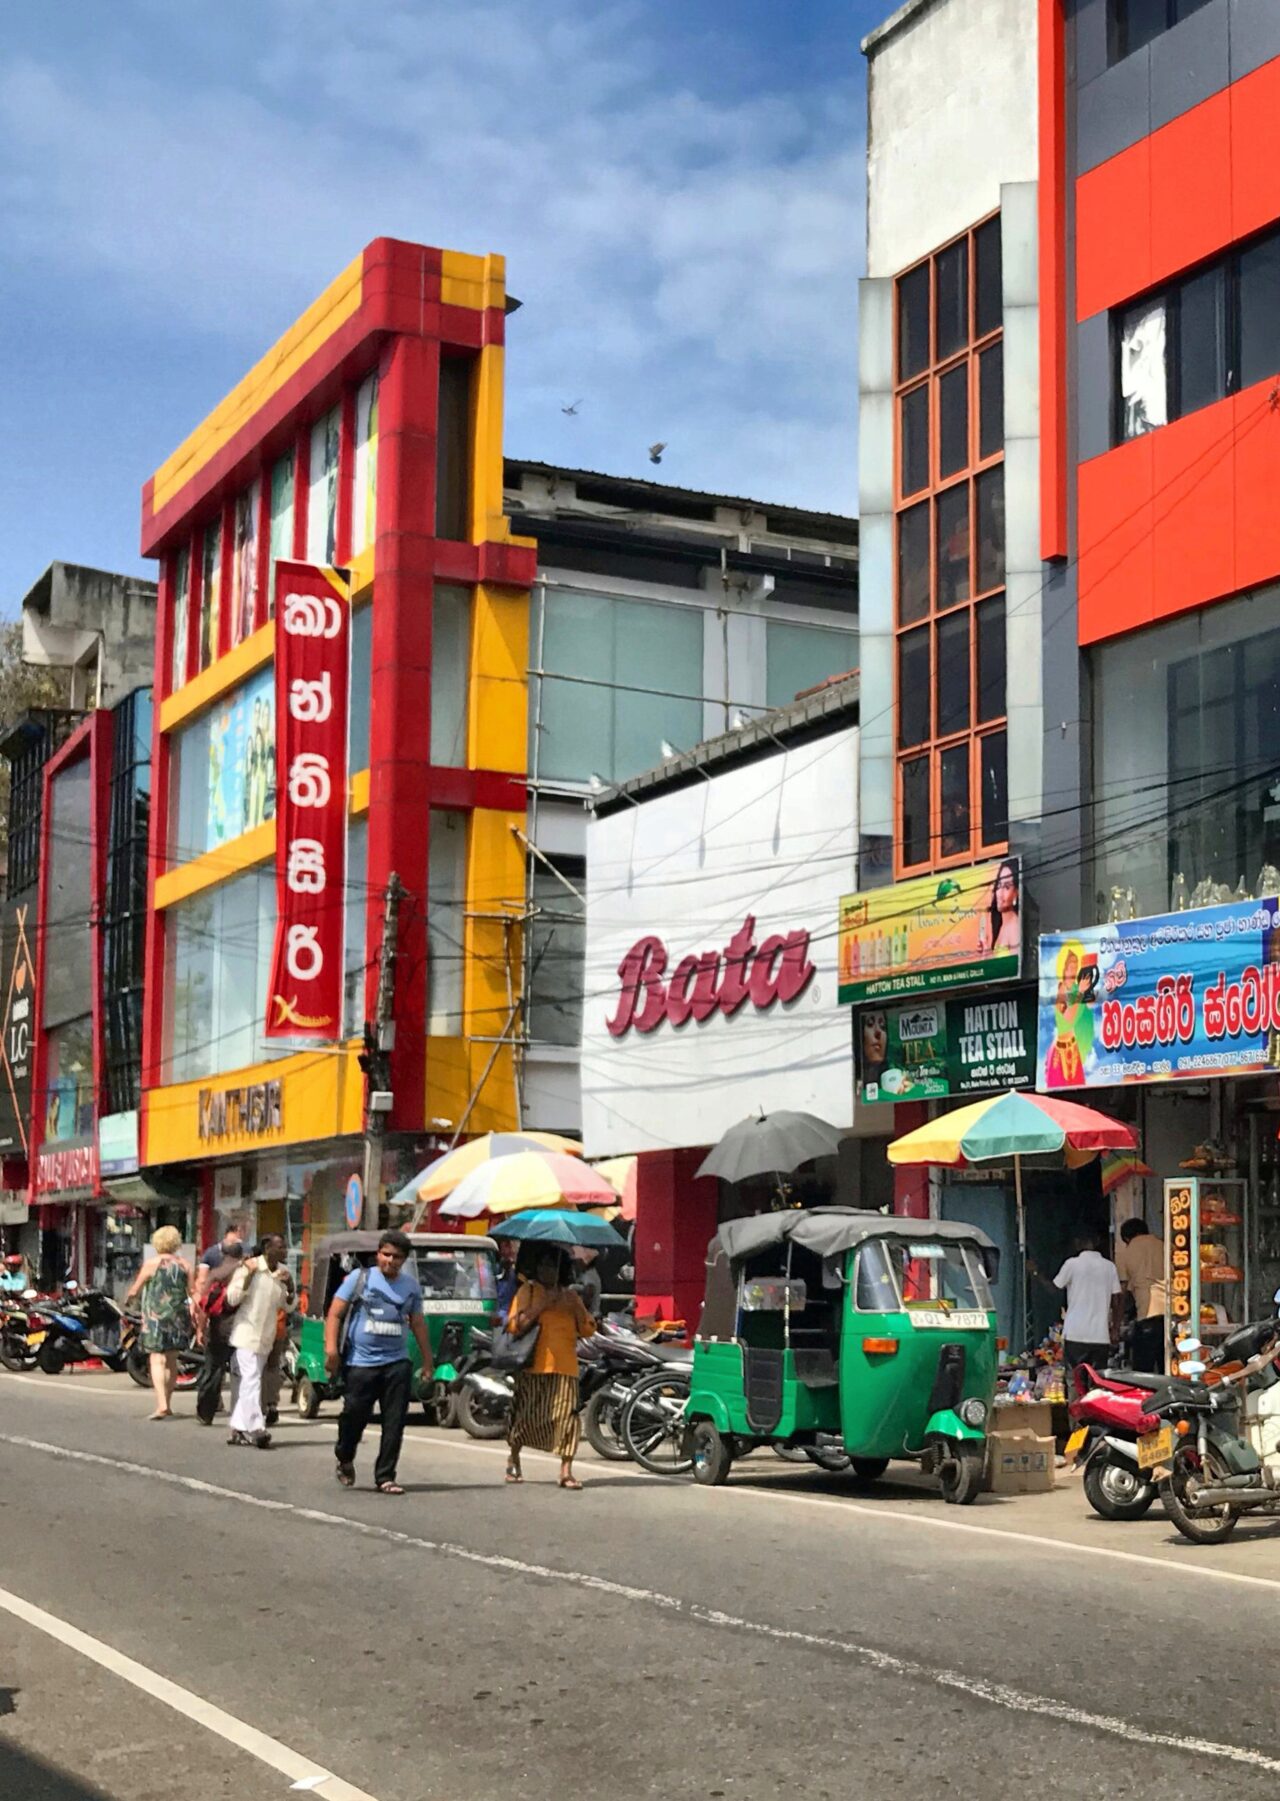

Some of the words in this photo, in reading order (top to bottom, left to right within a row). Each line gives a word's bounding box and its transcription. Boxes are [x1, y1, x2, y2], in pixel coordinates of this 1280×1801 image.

[606, 912, 816, 1037] Bata
[963, 1000, 1019, 1034] HATTON
[902, 1038, 937, 1064] TEA
[958, 1033, 984, 1065] TEA
[986, 1029, 1027, 1061] STALL
